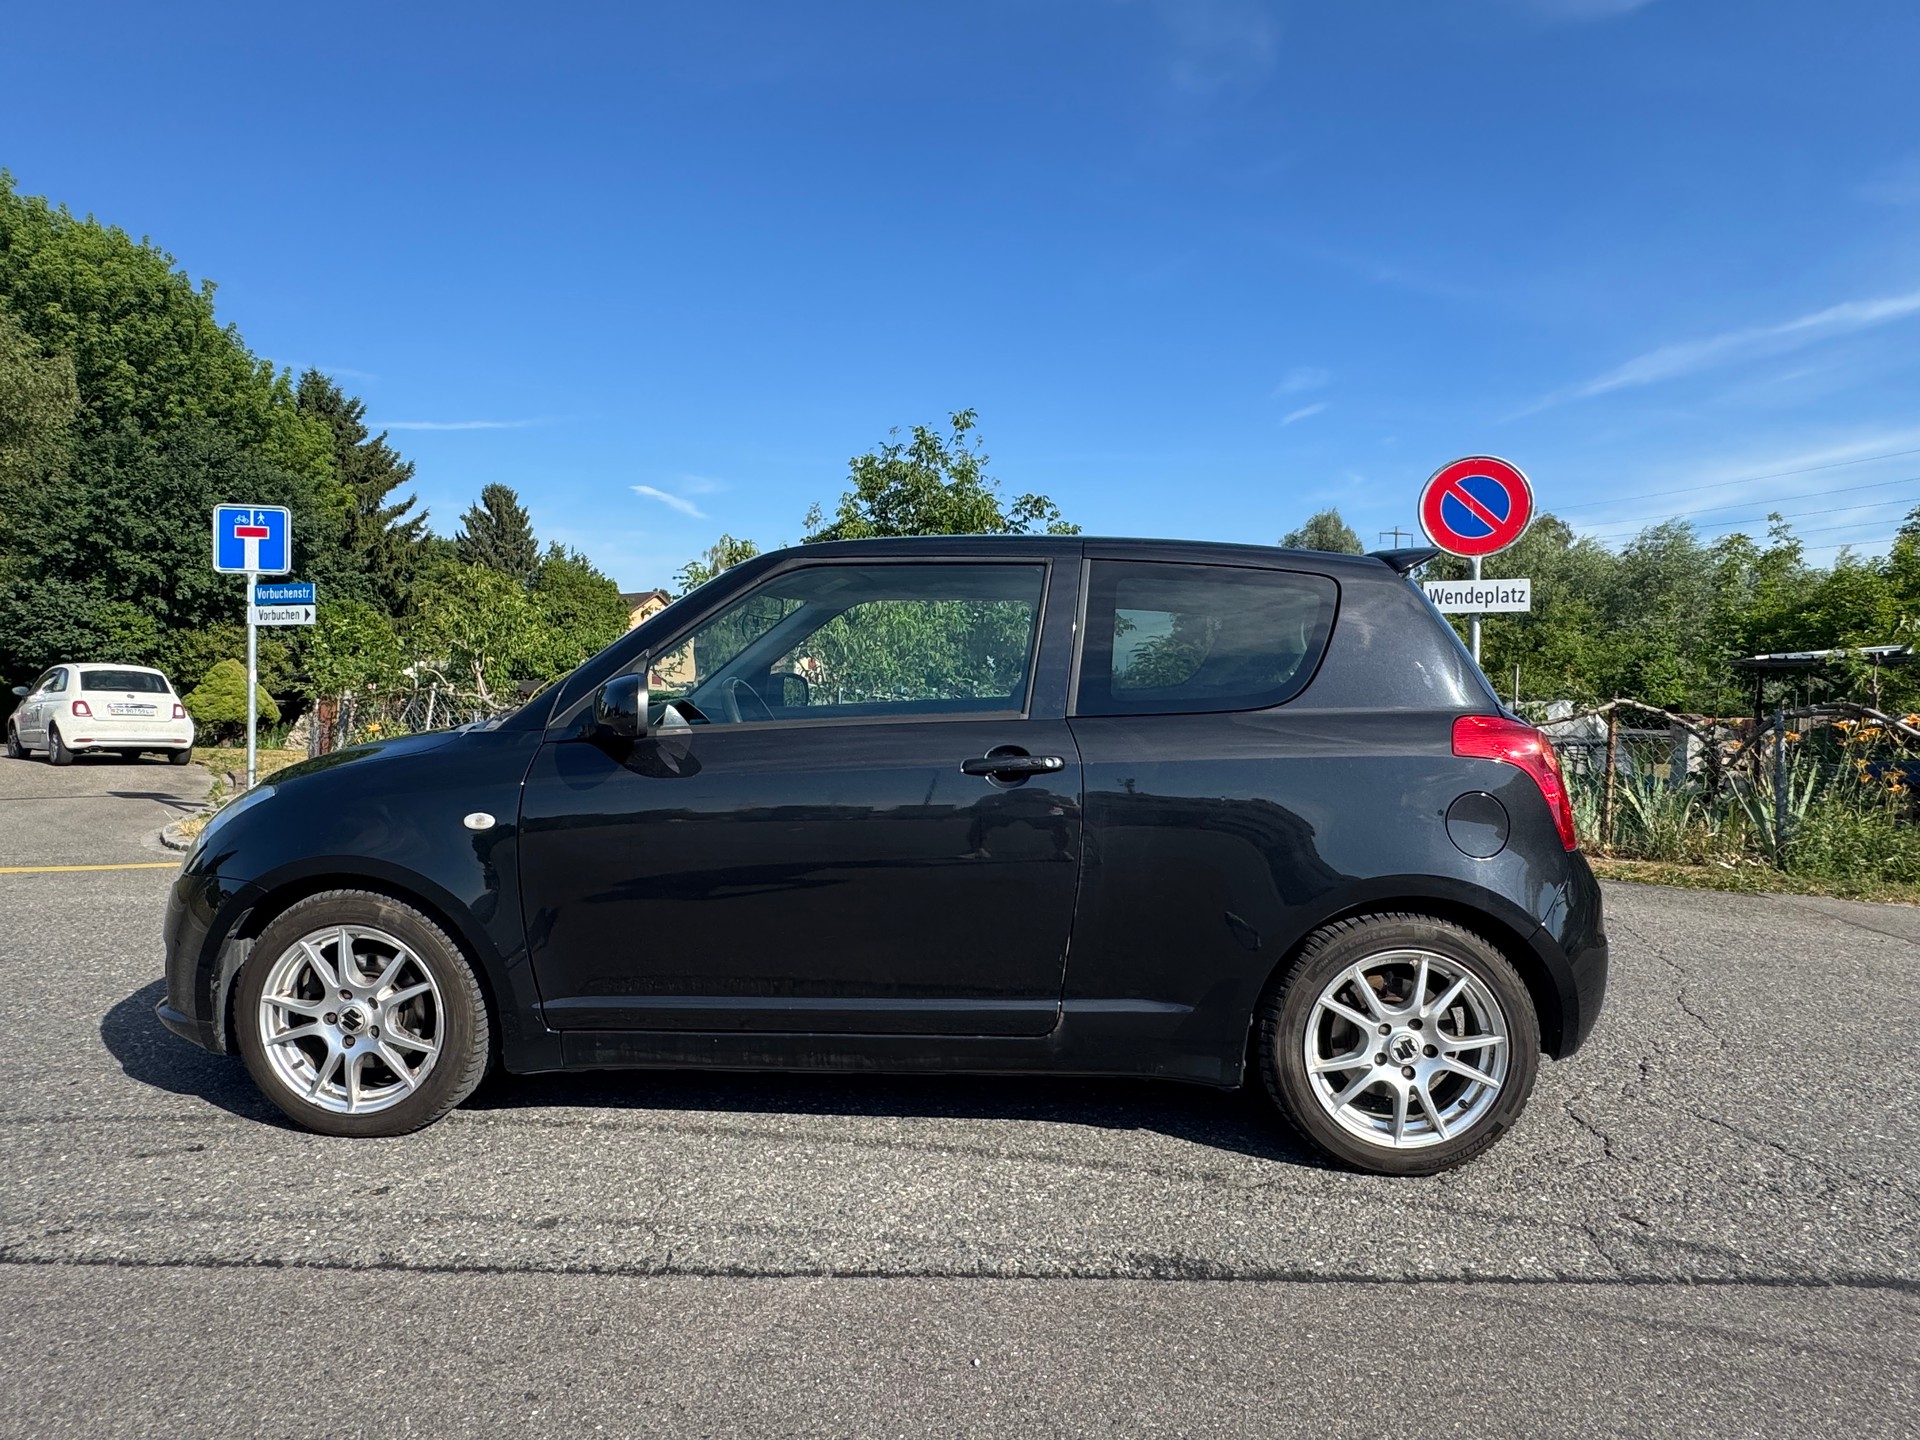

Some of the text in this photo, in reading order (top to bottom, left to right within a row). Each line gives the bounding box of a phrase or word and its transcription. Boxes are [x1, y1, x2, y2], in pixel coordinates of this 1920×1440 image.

[256, 587, 312, 599] Vorbuchenstr.
[1428, 585, 1526, 608] Wendeplatz
[258, 607, 300, 620] Vorbuchen
